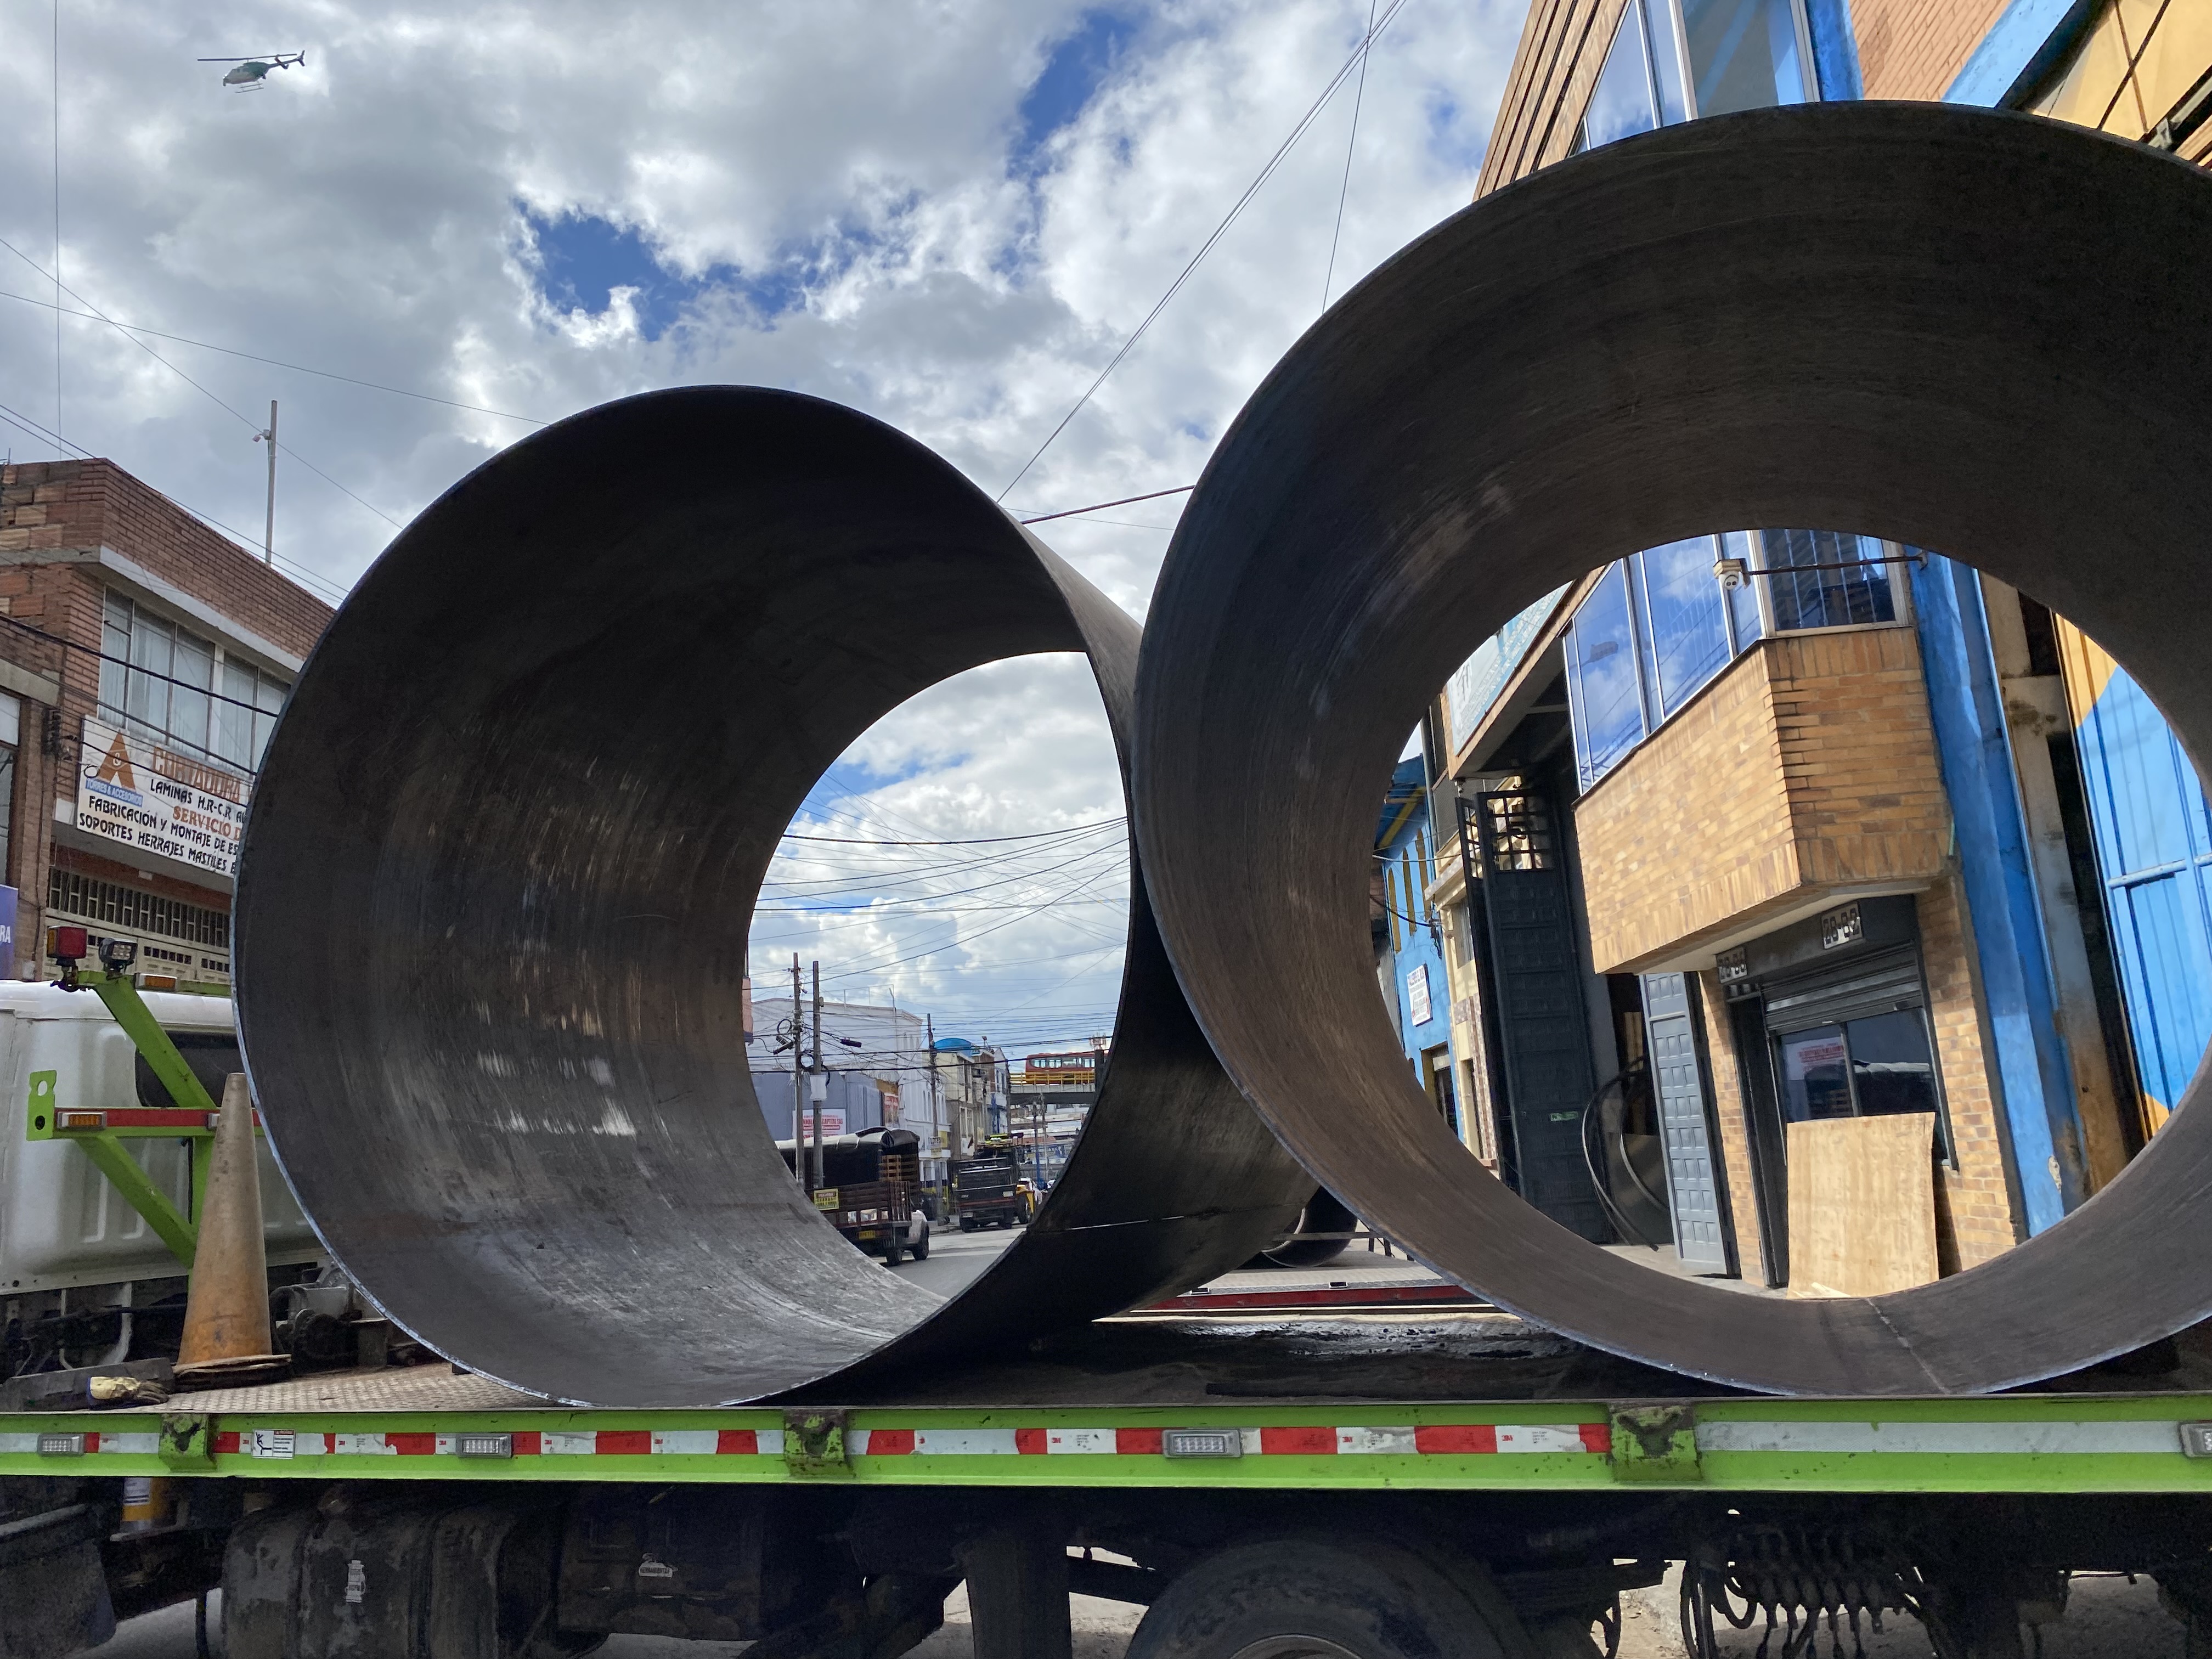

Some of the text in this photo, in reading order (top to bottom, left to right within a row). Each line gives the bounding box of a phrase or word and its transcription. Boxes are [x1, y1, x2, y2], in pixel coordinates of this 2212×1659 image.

[87, 778, 108, 793] TORRES
[150, 778, 193, 804] LAMINAS
[80, 813, 133, 840] SOPORTES
[138, 831, 184, 857] HERRAJES
[89, 795, 157, 828] FABRICACIÓN
[160, 819, 167, 831] Y
[171, 823, 211, 847] MONTAJE
[214, 837, 226, 852] DE
[173, 806, 231, 837] SERVICIO
